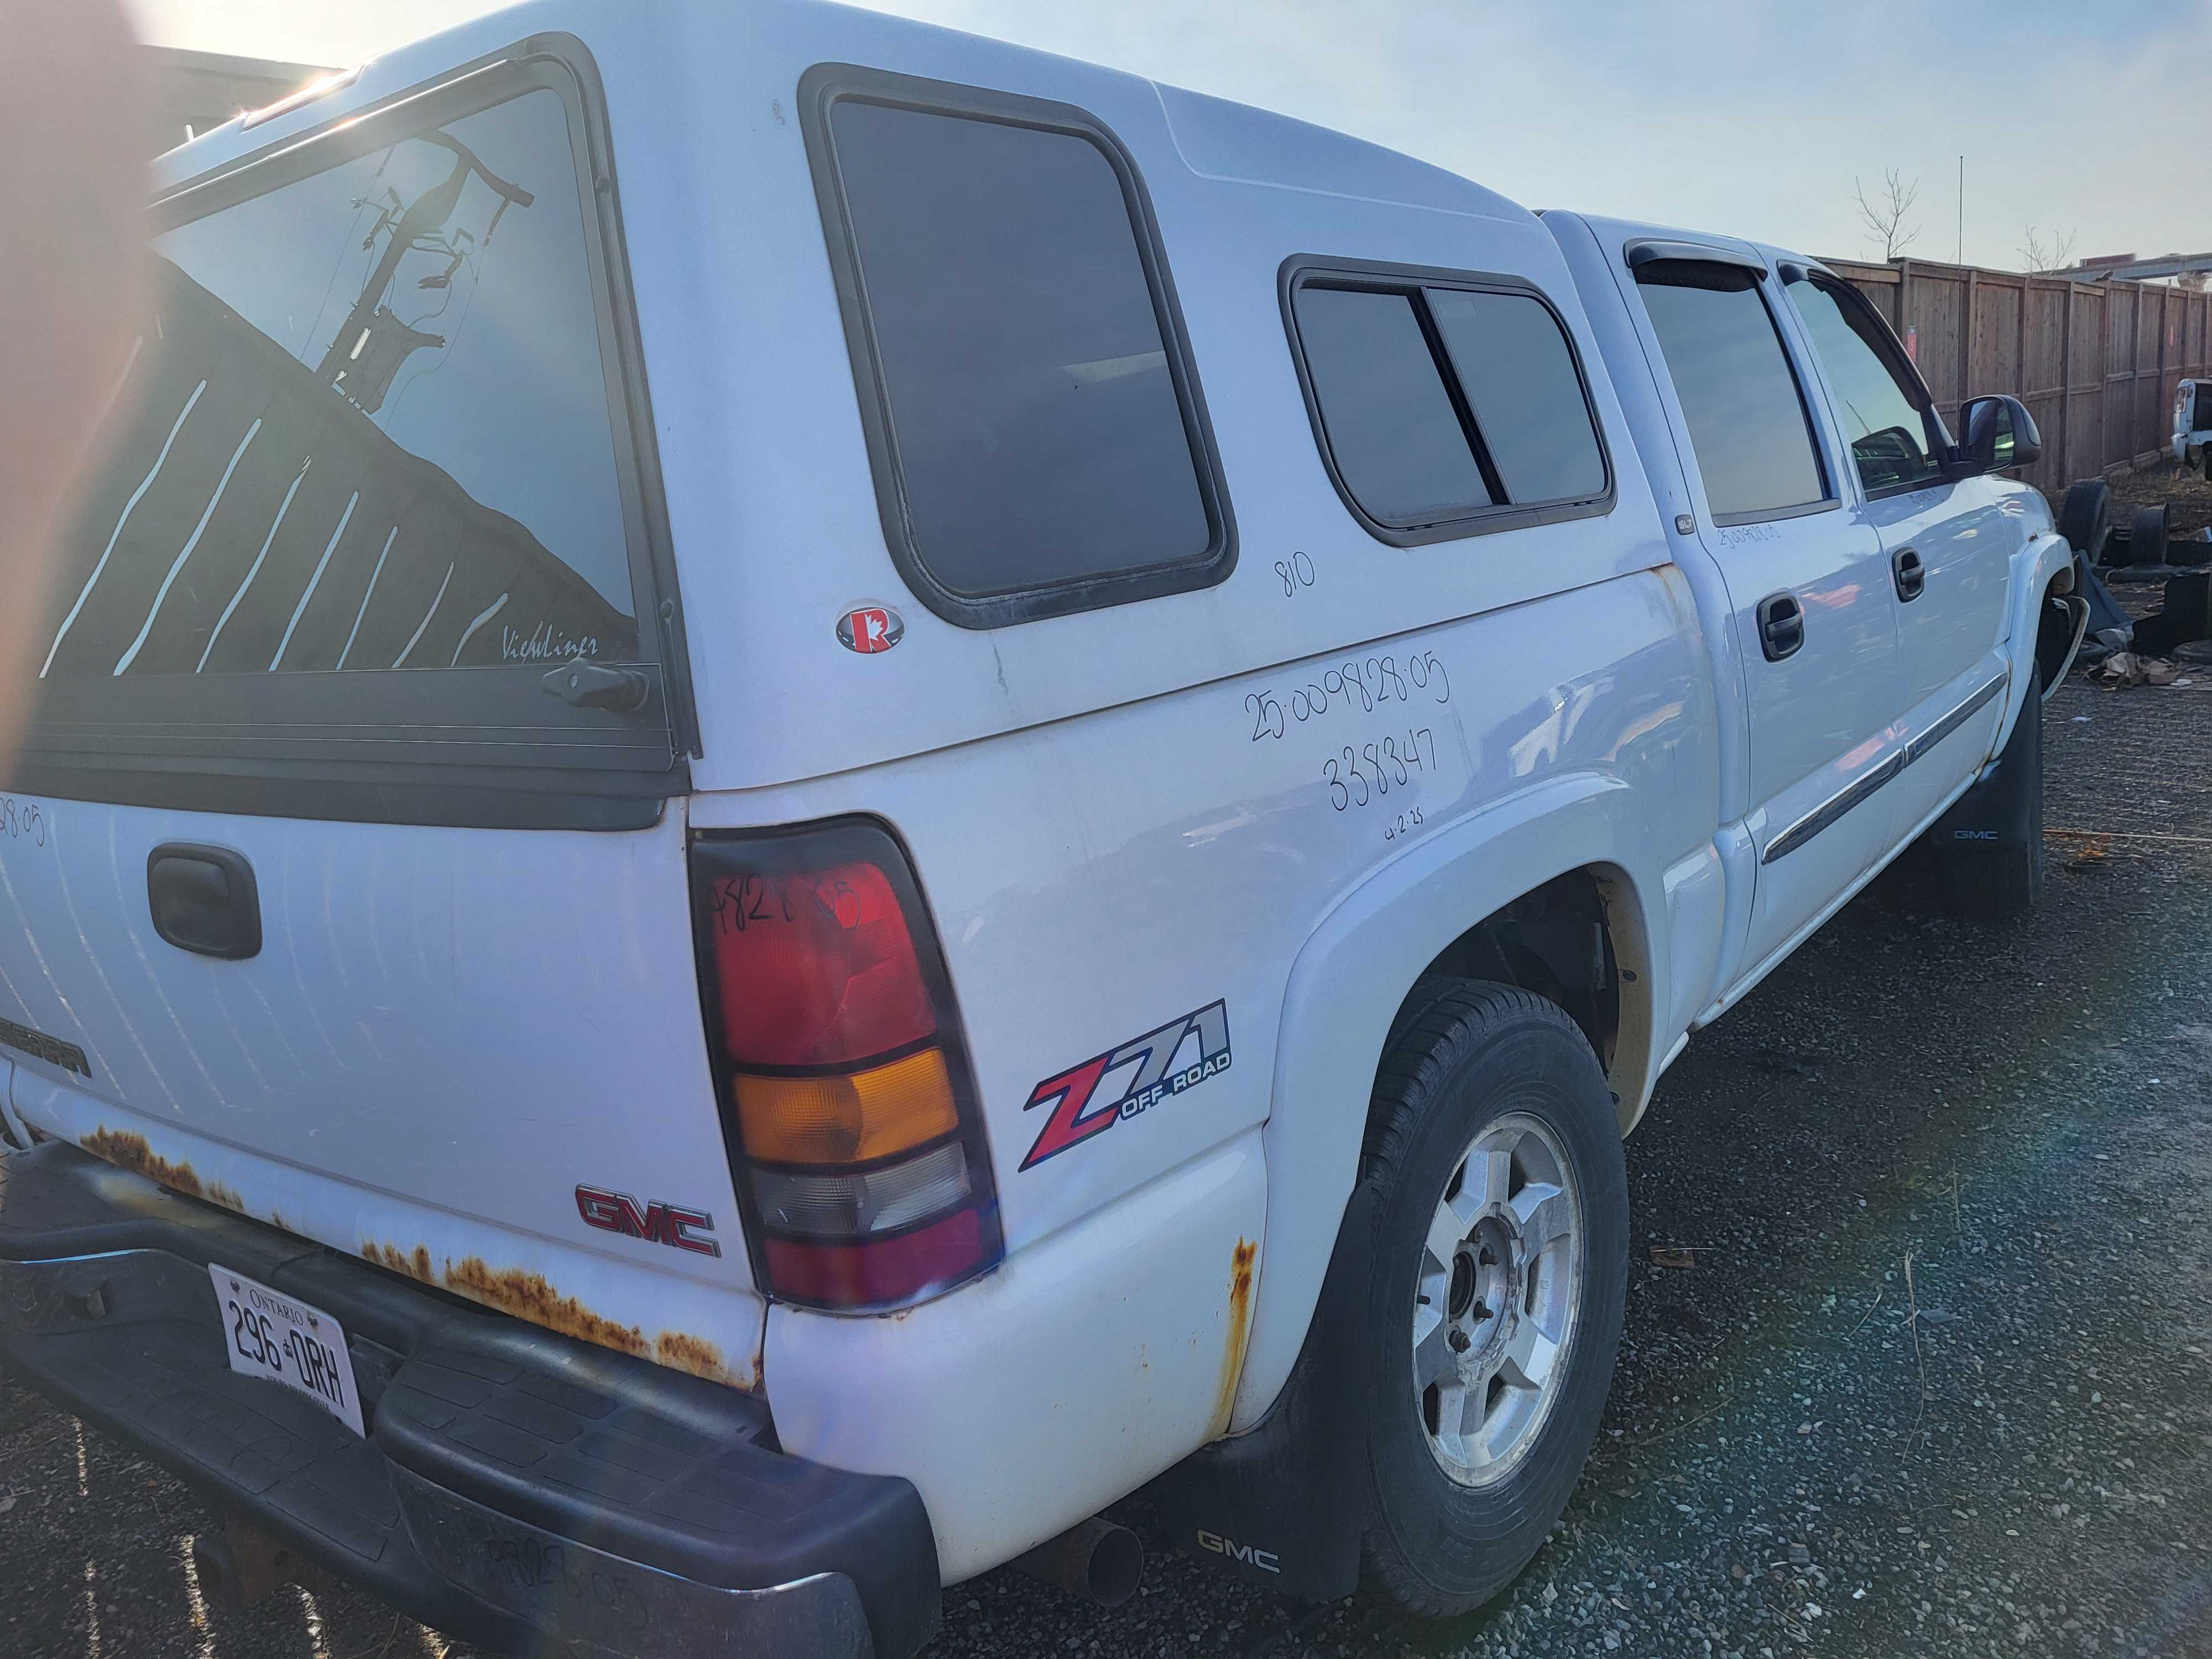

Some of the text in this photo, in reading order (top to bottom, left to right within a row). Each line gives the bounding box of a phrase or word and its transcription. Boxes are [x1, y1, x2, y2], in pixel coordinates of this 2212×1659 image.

[1677, 519, 1692, 530] SLT
[1274, 551, 1316, 598] 810
[1323, 728, 1437, 812] 338347
[1954, 830, 1999, 840] GMC
[1018, 998, 1230, 1173] Z71
[1121, 1052, 1232, 1120] OFF ROAD
[575, 1183, 722, 1258] GMC
[1197, 1528, 1281, 1574] GMC
